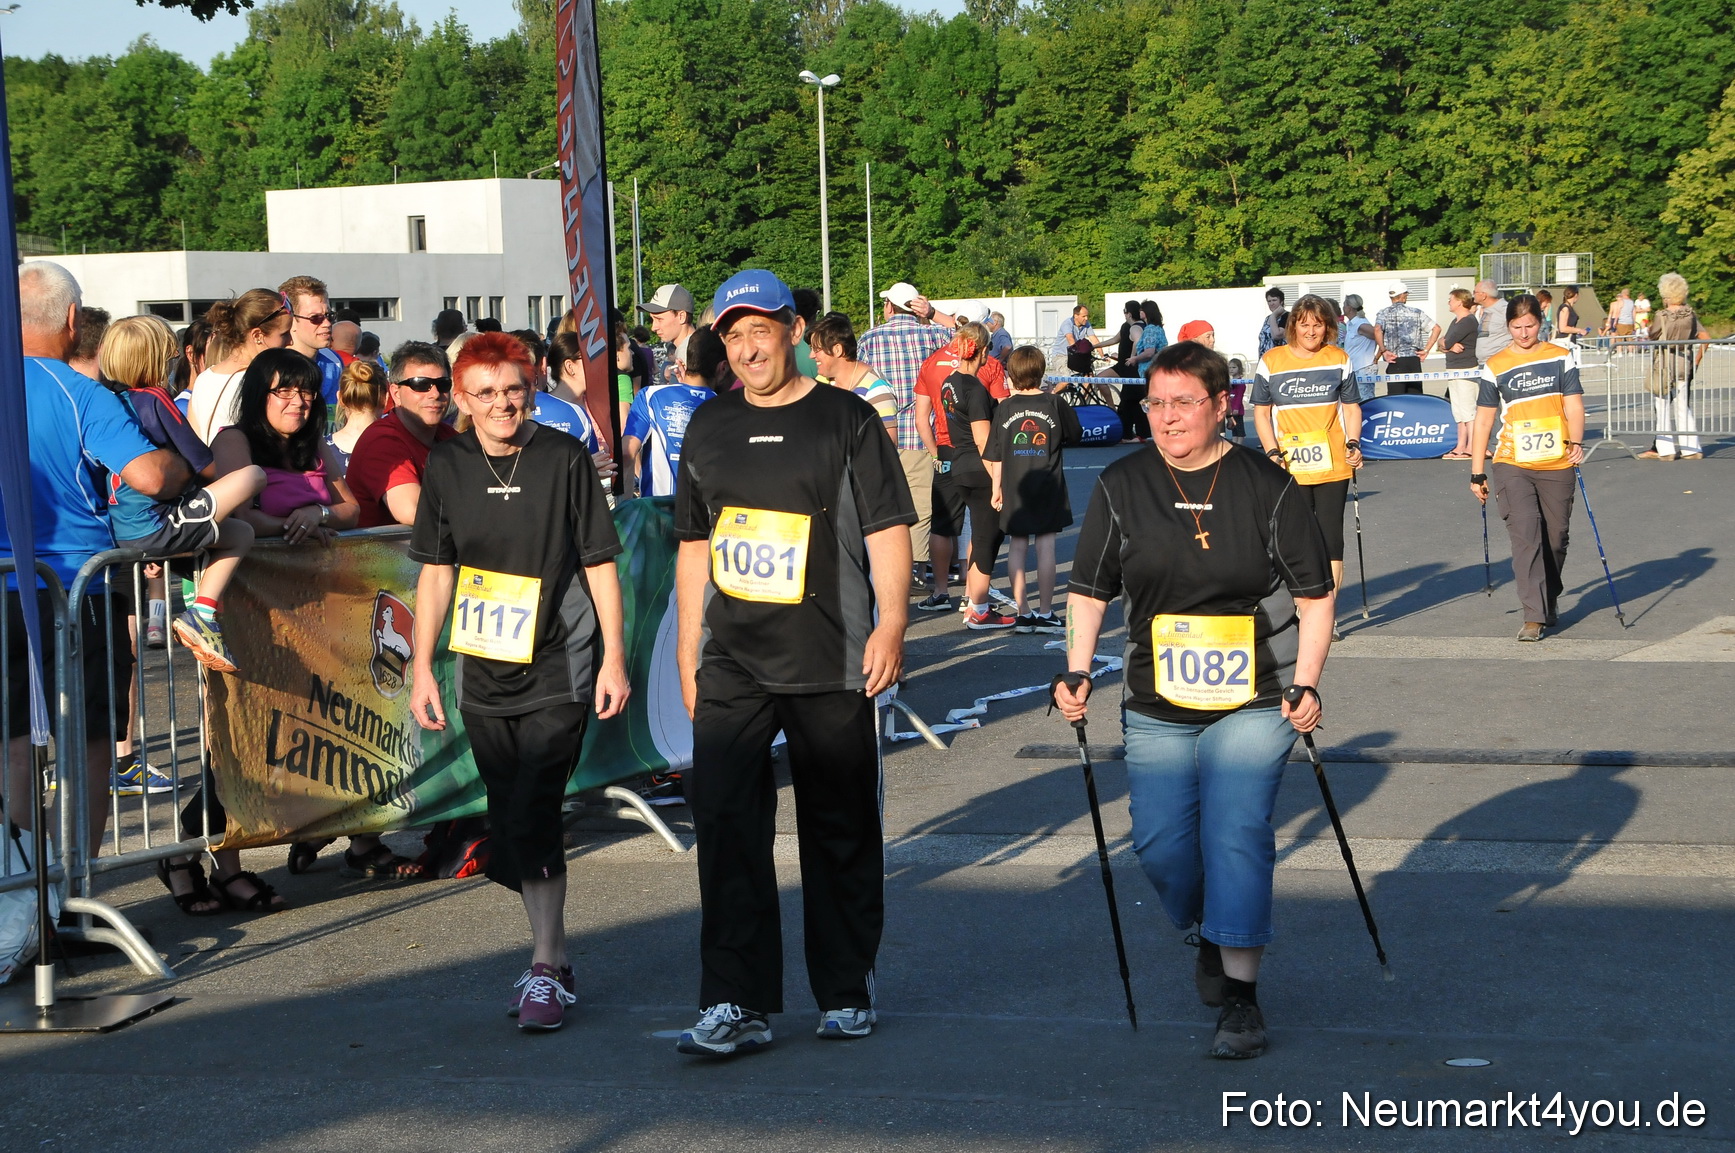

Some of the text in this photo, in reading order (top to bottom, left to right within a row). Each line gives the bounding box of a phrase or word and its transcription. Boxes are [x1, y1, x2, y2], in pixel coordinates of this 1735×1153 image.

[725, 283, 760, 302] Assisi
[1287, 383, 1332, 394] Fischer
[1517, 375, 1556, 388] Fischer
[1373, 422, 1450, 439] Fischer
[1380, 436, 1444, 446] AUTOMOBILE
[1521, 432, 1555, 452] 373
[1291, 445, 1323, 464] 408
[715, 538, 796, 581] 1081
[458, 597, 532, 640] 1117
[1158, 647, 1249, 686] 1082
[379, 666, 397, 690] 1628
